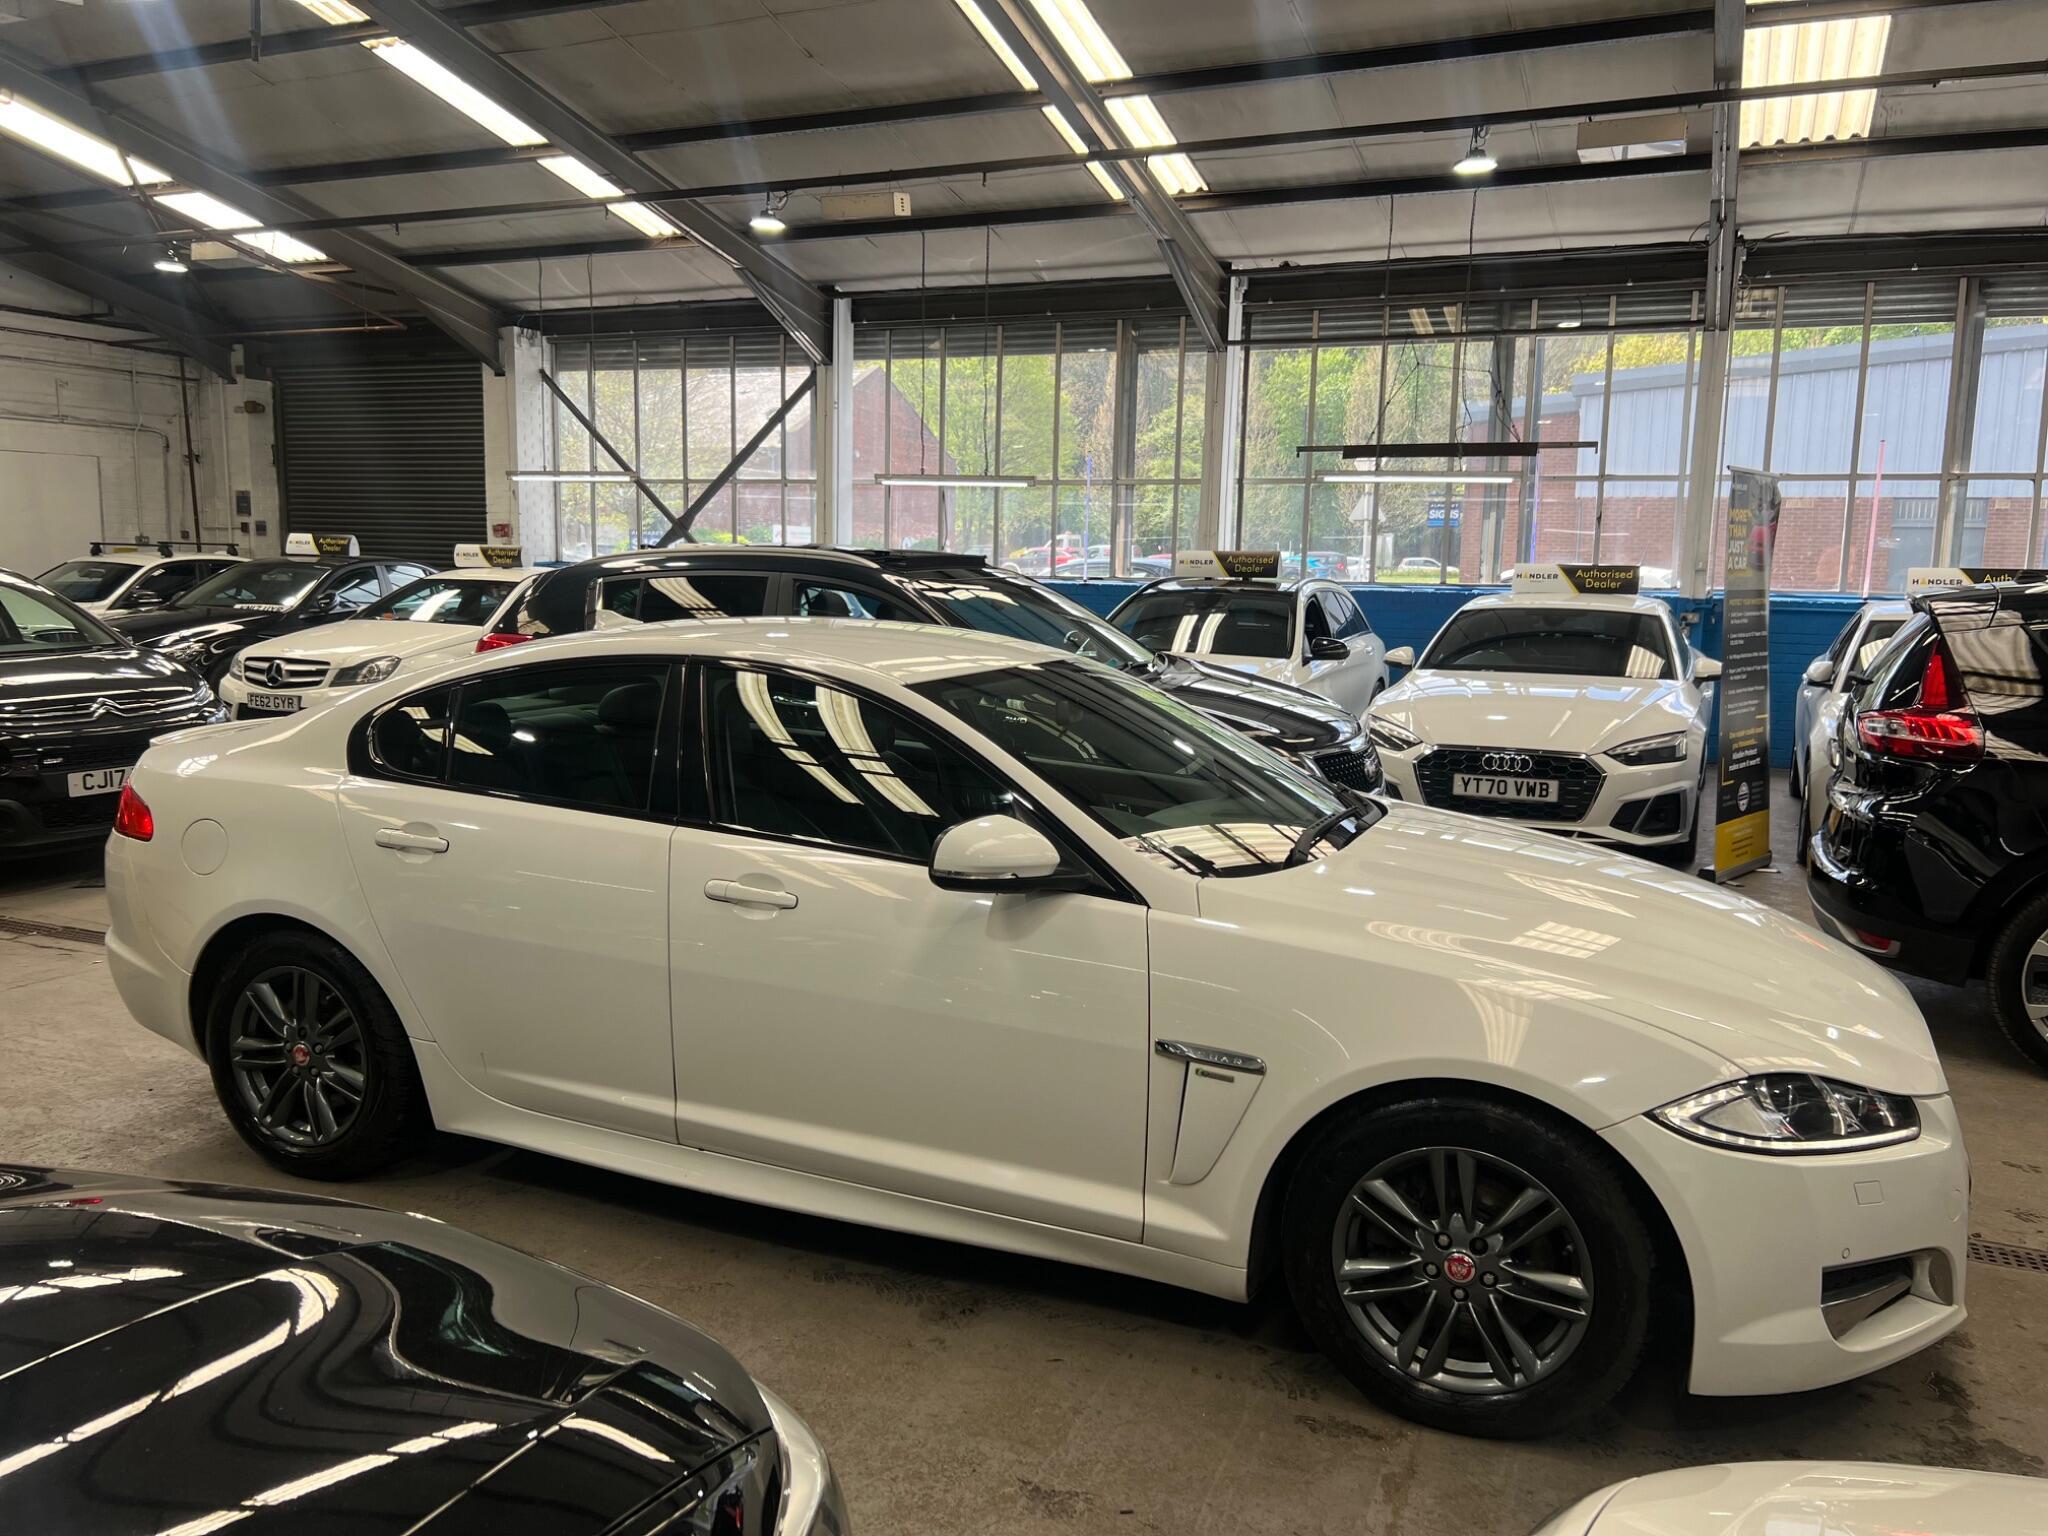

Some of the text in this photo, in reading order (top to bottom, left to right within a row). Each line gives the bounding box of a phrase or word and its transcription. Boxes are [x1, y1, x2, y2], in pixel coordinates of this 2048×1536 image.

[1428, 509, 1460, 519] SIGS
[1728, 524, 1747, 538] THAN
[1728, 540, 1744, 554] JUST
[1226, 555, 1275, 564] Authorised
[1733, 556, 1748, 570] CAR
[1234, 564, 1264, 573] Dealer
[1575, 569, 1634, 579] Authorised
[1585, 578, 1622, 589] Dealer
[250, 694, 295, 709] FE62 GYR
[82, 768, 126, 791] CJ17
[1461, 776, 1550, 798] YT70 VWB
